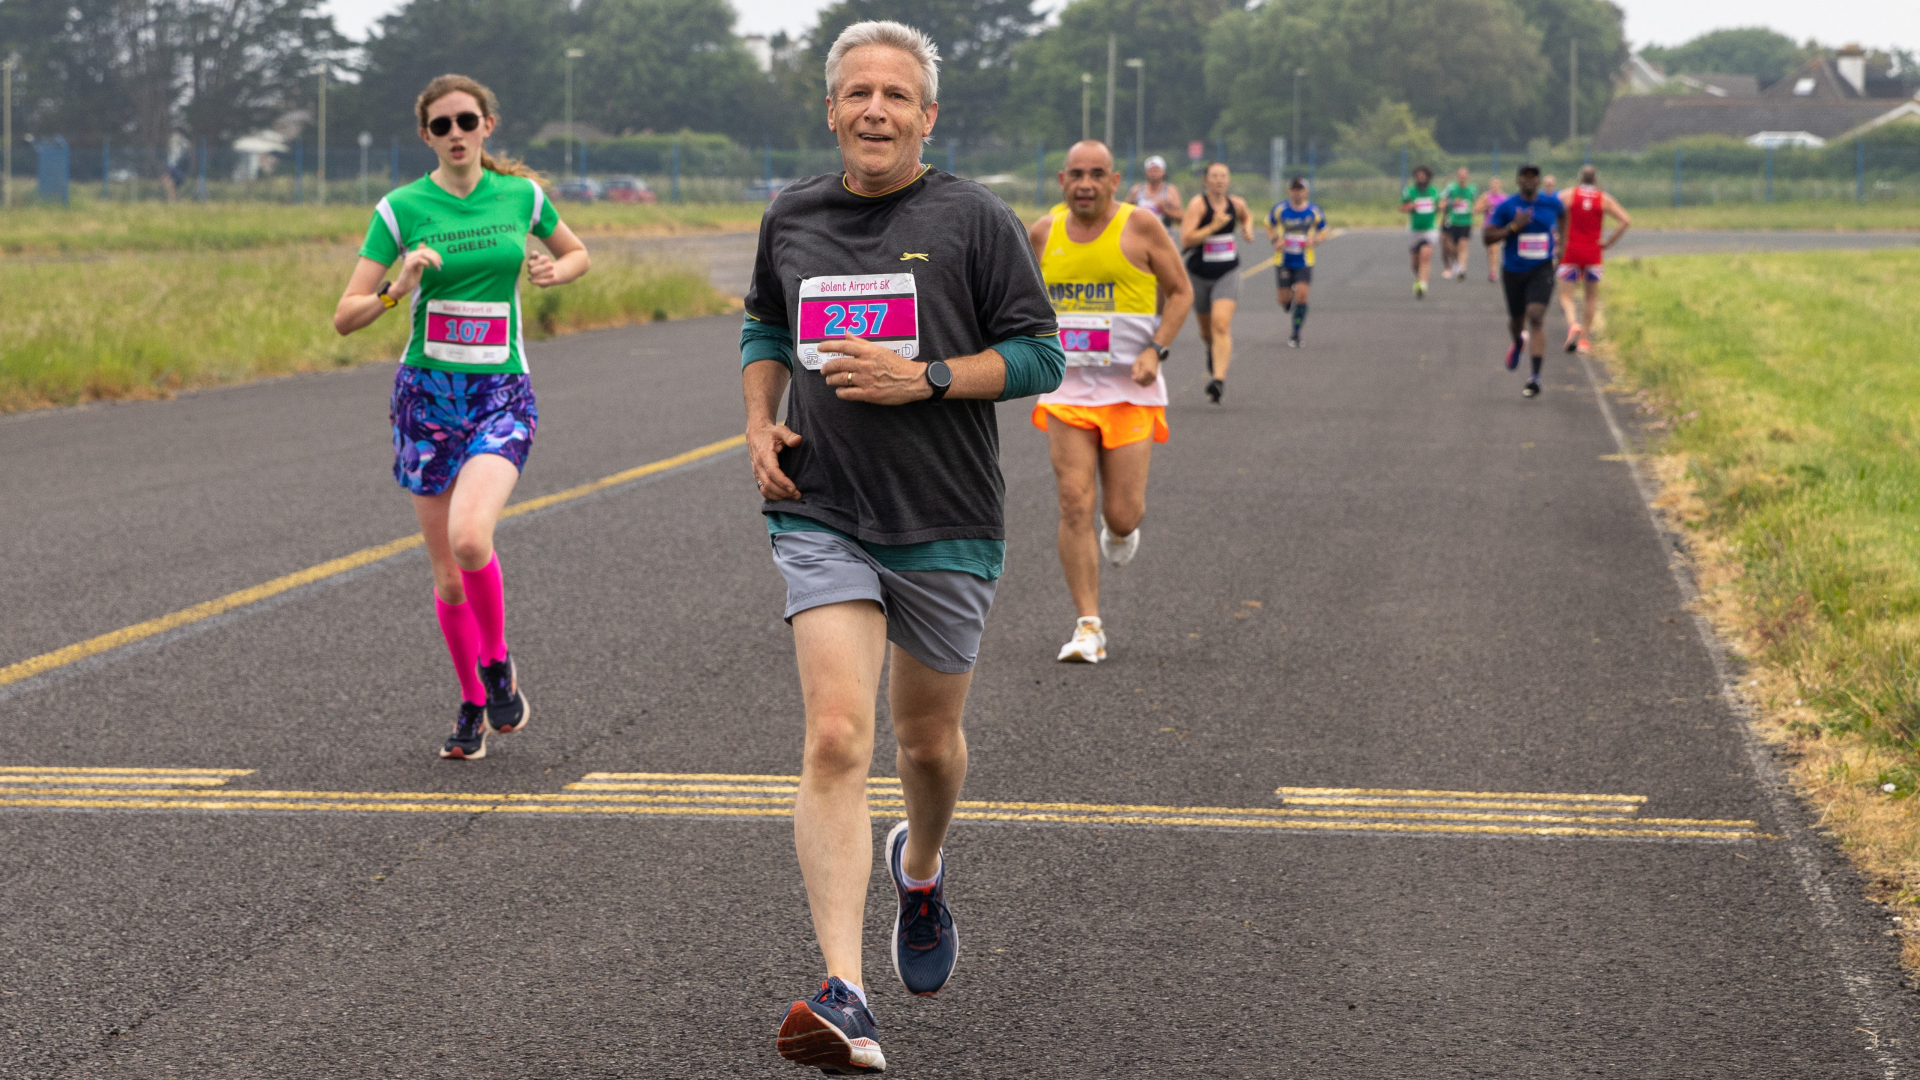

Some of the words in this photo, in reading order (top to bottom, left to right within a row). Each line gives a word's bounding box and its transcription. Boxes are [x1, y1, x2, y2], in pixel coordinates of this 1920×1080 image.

[422, 224, 516, 245] STUBBINGTON
[446, 238, 497, 254] GREEN
[821, 281, 847, 293] Solent
[849, 280, 878, 294] Airport
[880, 279, 890, 290] 5K
[824, 303, 888, 336] 237
[445, 319, 490, 342] 107
